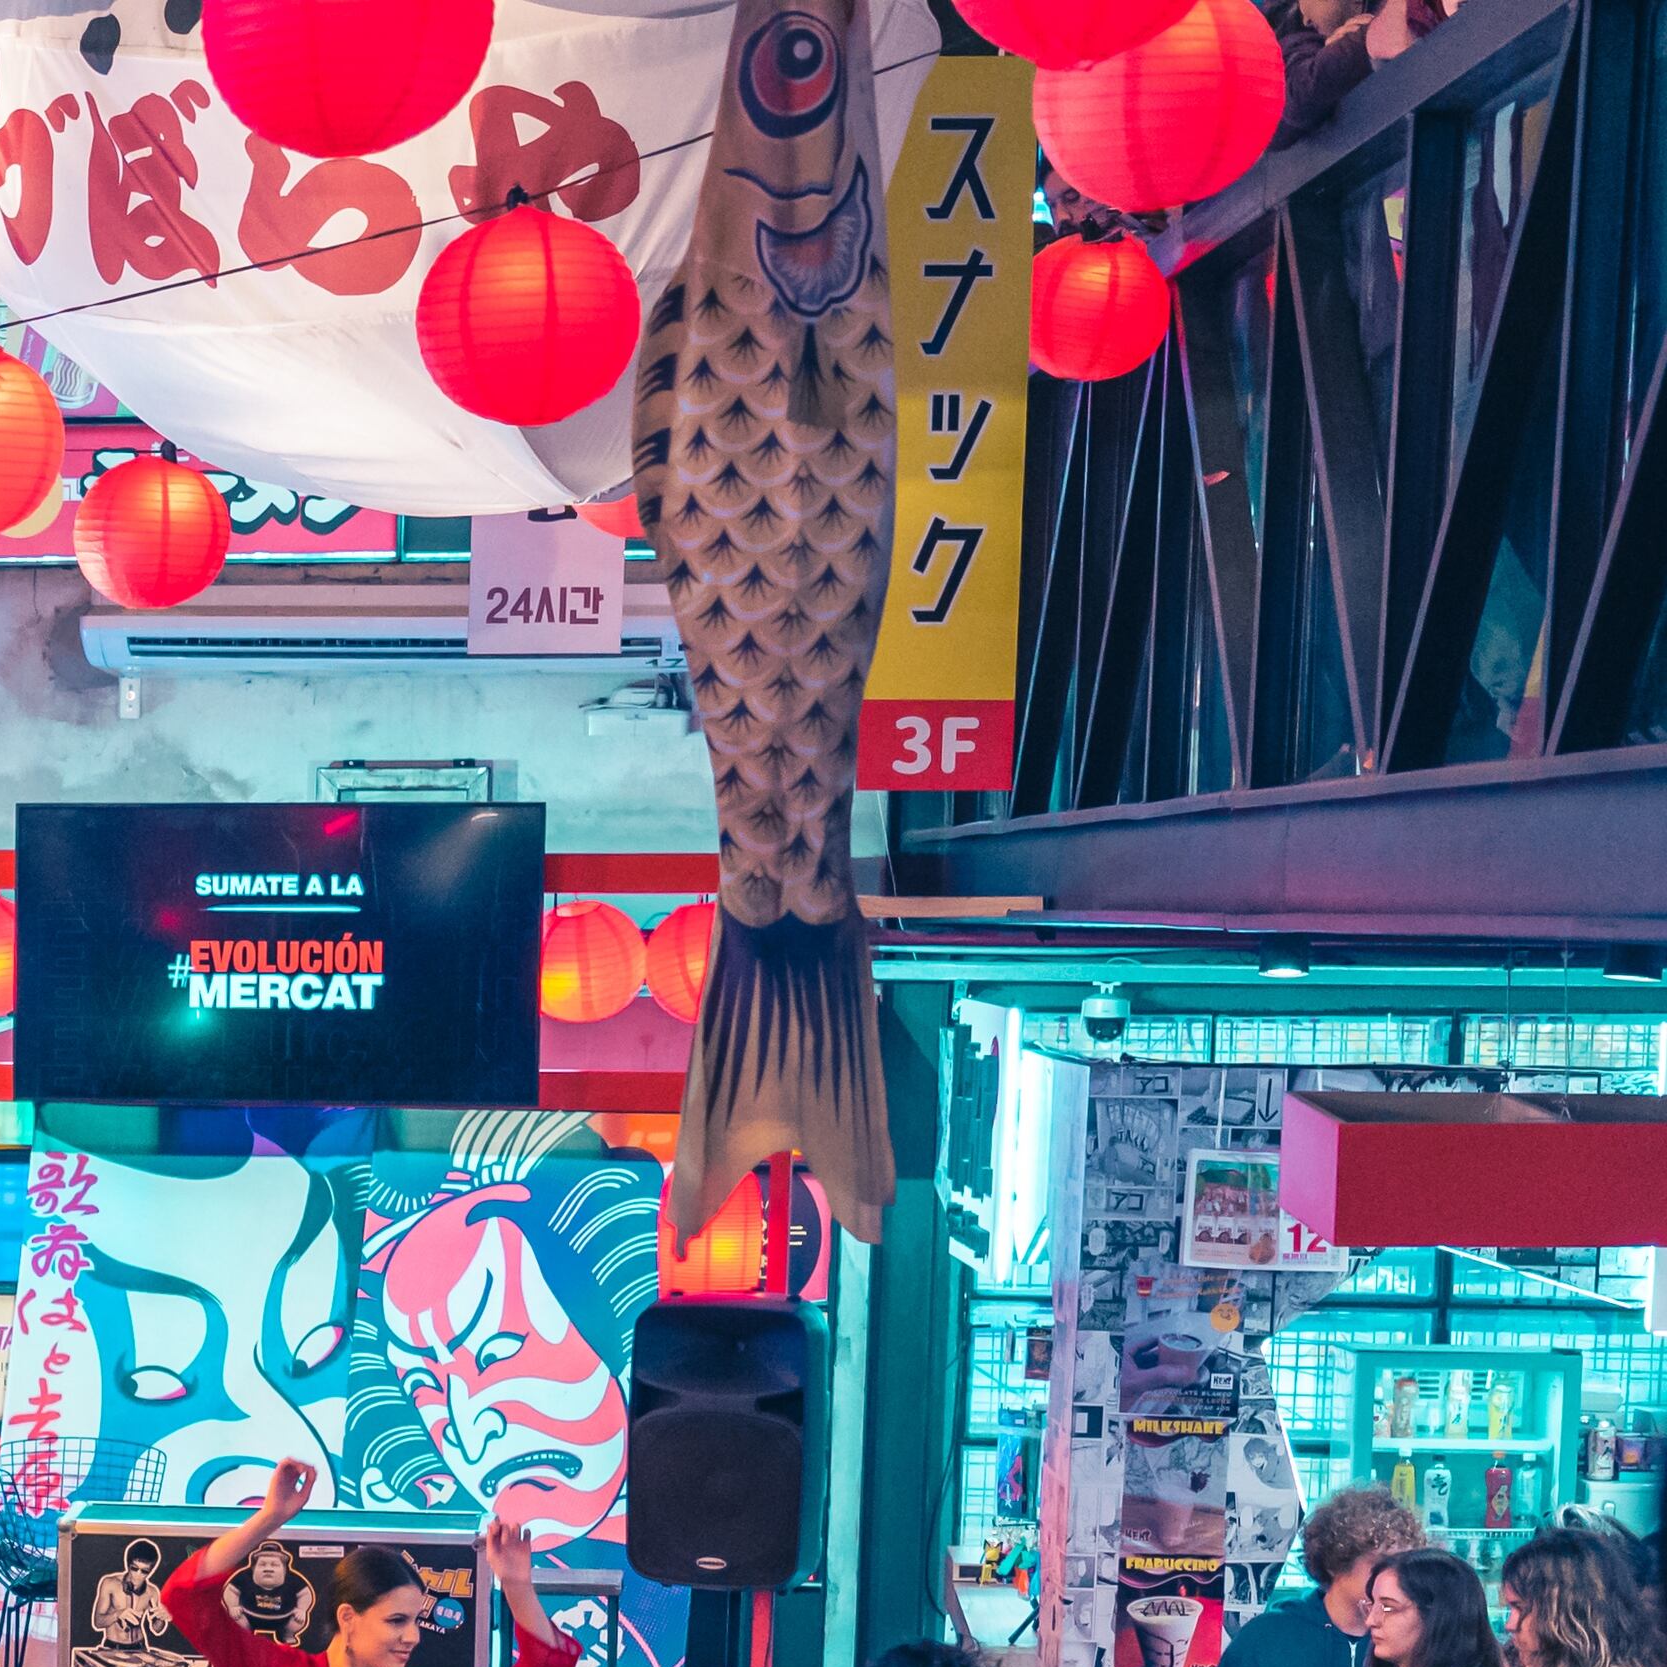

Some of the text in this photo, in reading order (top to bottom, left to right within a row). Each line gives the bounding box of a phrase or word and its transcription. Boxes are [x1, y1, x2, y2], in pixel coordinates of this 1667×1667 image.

[919, 115, 995, 625] スナック
[486, 587, 604, 625] 24시간
[892, 716, 980, 775] 3F
[195, 873, 365, 896] SUMATE A LA
[188, 973, 385, 1010] MERCAT
[1133, 1418, 1225, 1435] MILKSHAKE
[1125, 1555, 1219, 1572] FRAPUCCINO
